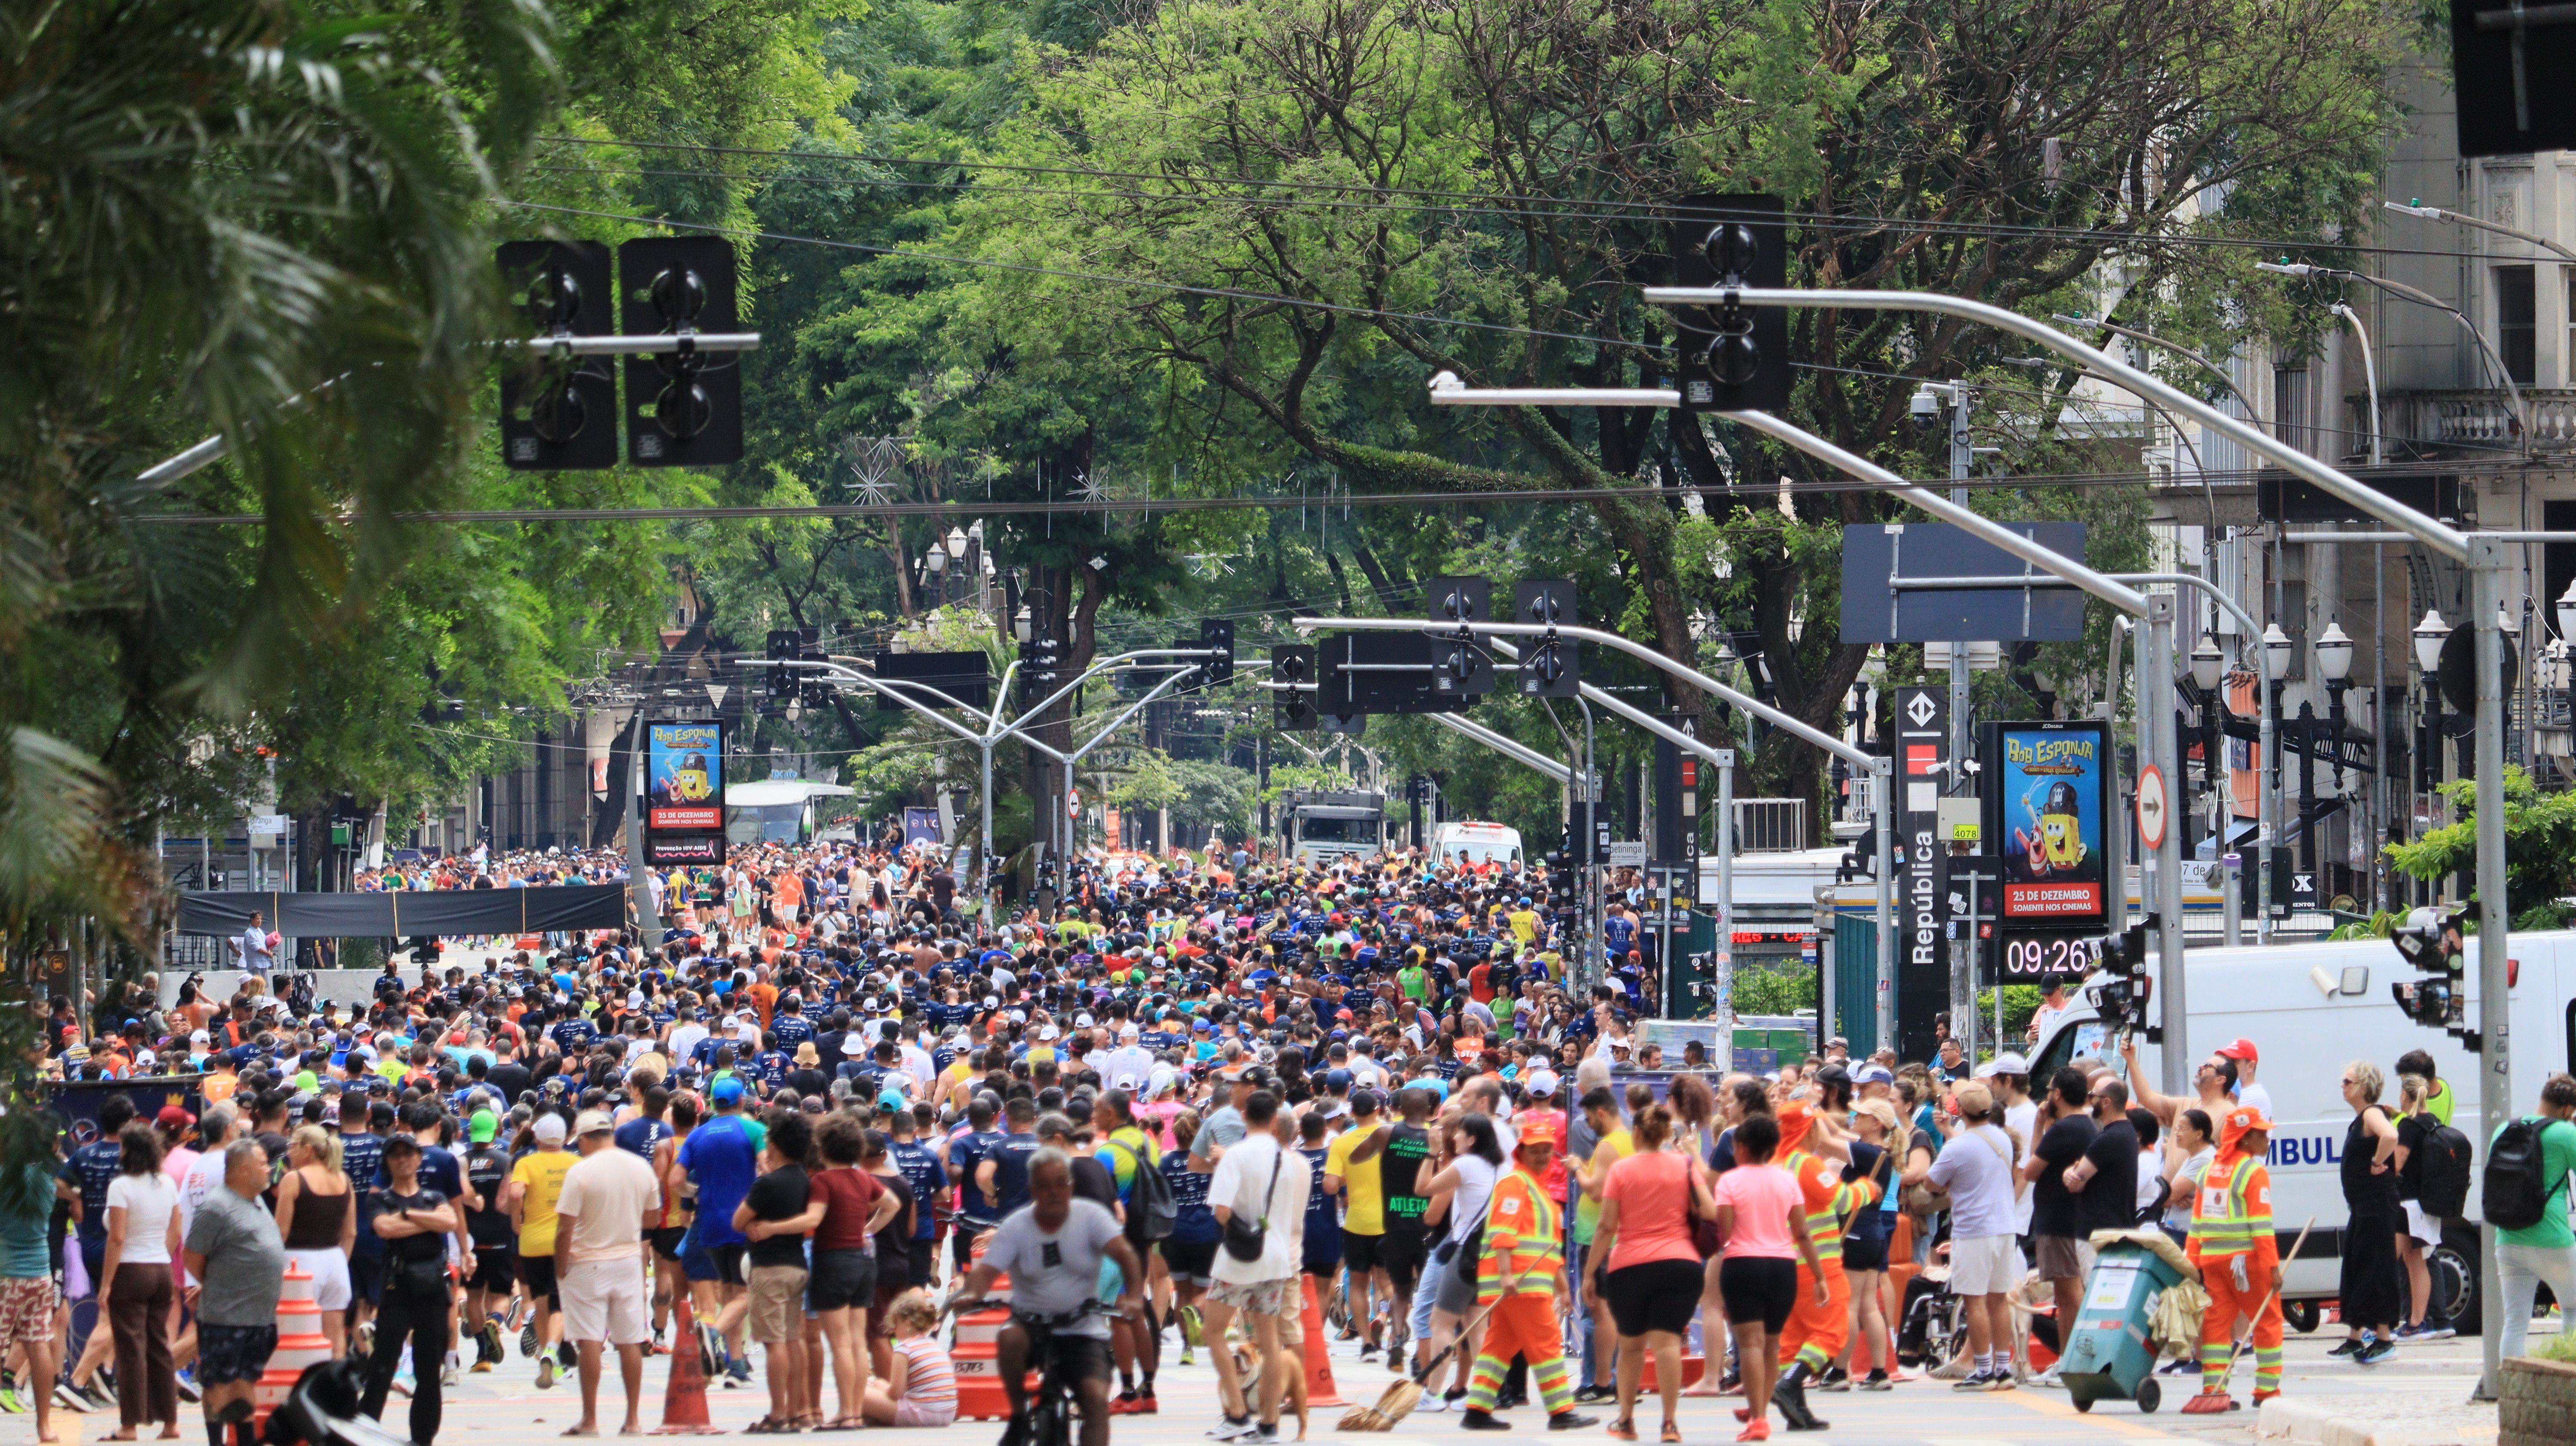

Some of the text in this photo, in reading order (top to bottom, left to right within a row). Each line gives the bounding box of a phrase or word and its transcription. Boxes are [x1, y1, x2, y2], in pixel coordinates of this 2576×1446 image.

[674, 728, 717, 742] ESPONJA
[2036, 739, 2093, 763] ESPONJA
[2183, 864, 2205, 876] 7 de
[1912, 831, 1938, 964] República
[2013, 890, 2090, 901] 25 DE DEZEMBRO
[2062, 902, 2092, 911] CINEMAS
[2008, 940, 2086, 974] 09:26
[1390, 1197, 1428, 1212] ATLETA
